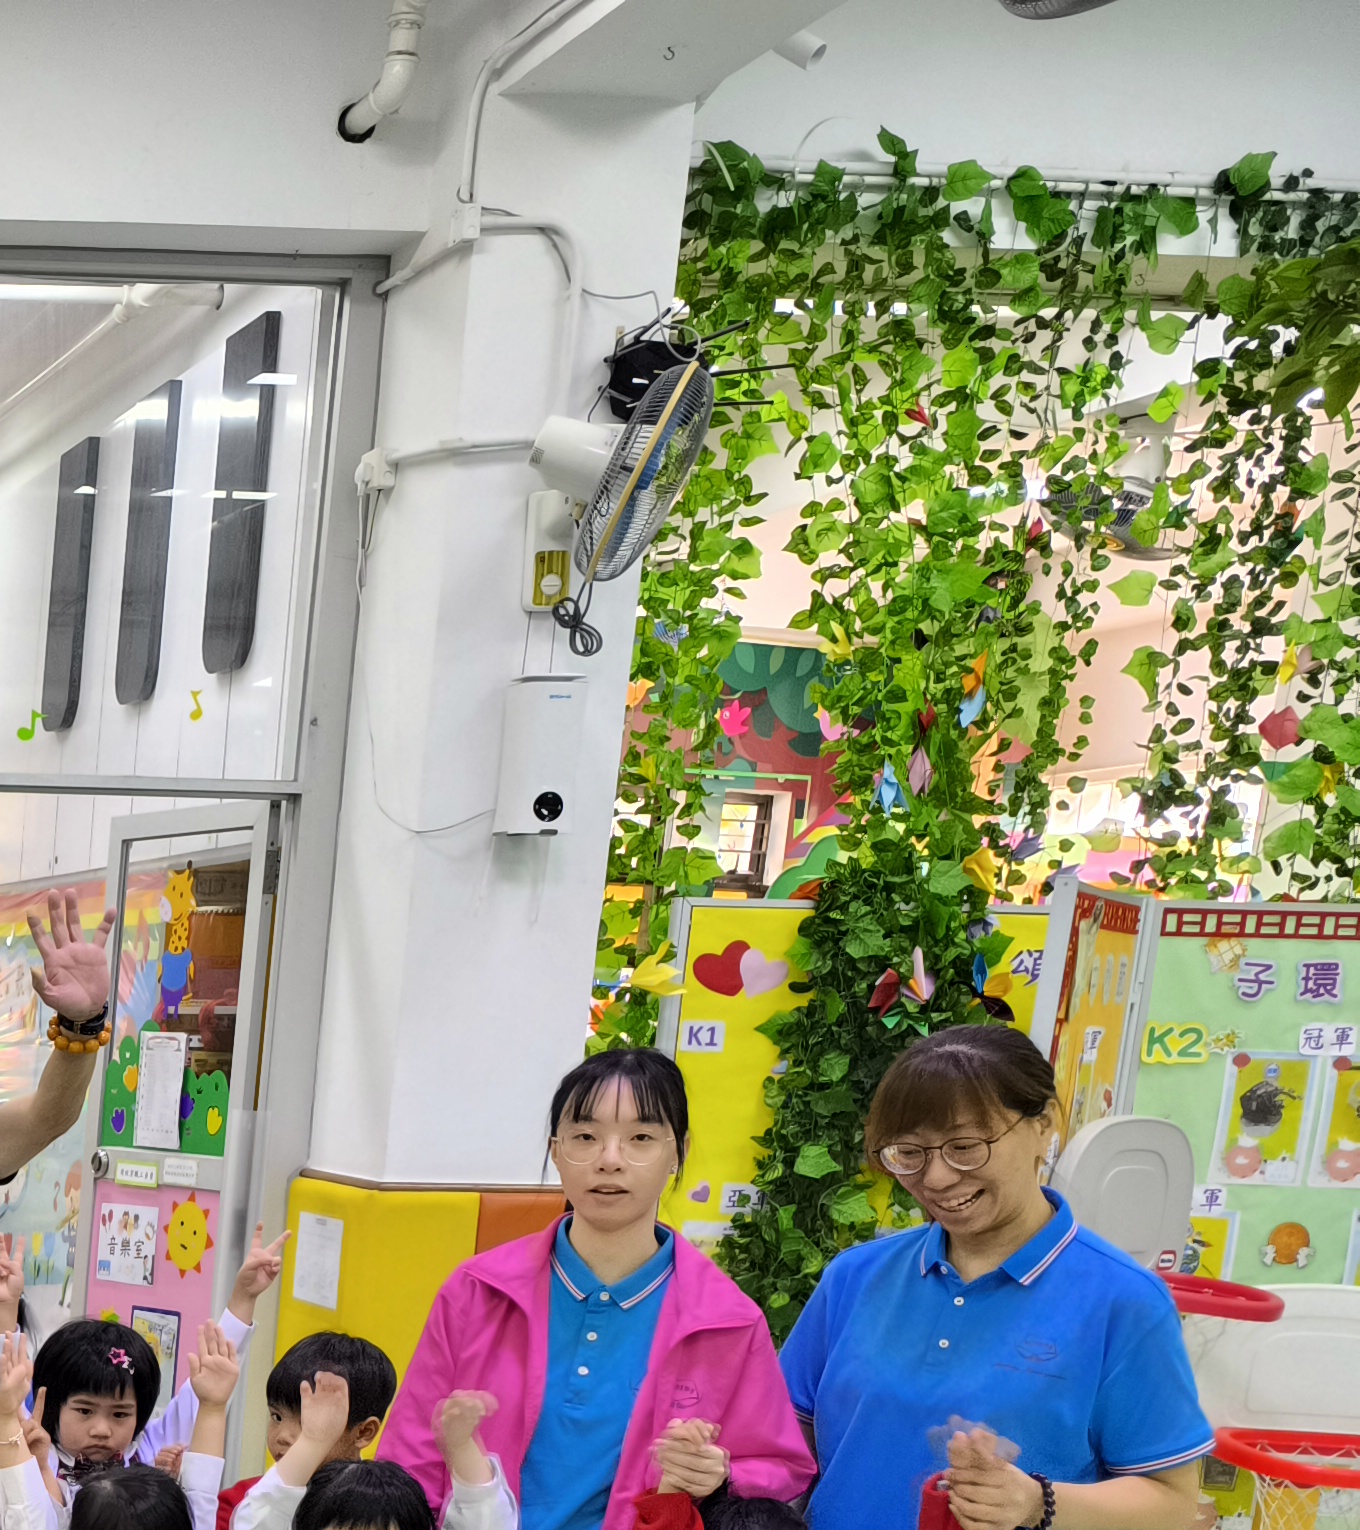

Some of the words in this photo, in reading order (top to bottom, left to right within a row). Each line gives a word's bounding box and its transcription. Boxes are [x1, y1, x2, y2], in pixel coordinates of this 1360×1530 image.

[687, 1025, 718, 1047] K1
[1146, 1026, 1204, 1058] K2
[1301, 1027, 1357, 1052] 冠軍
[108, 1235, 145, 1259] 音樂室
